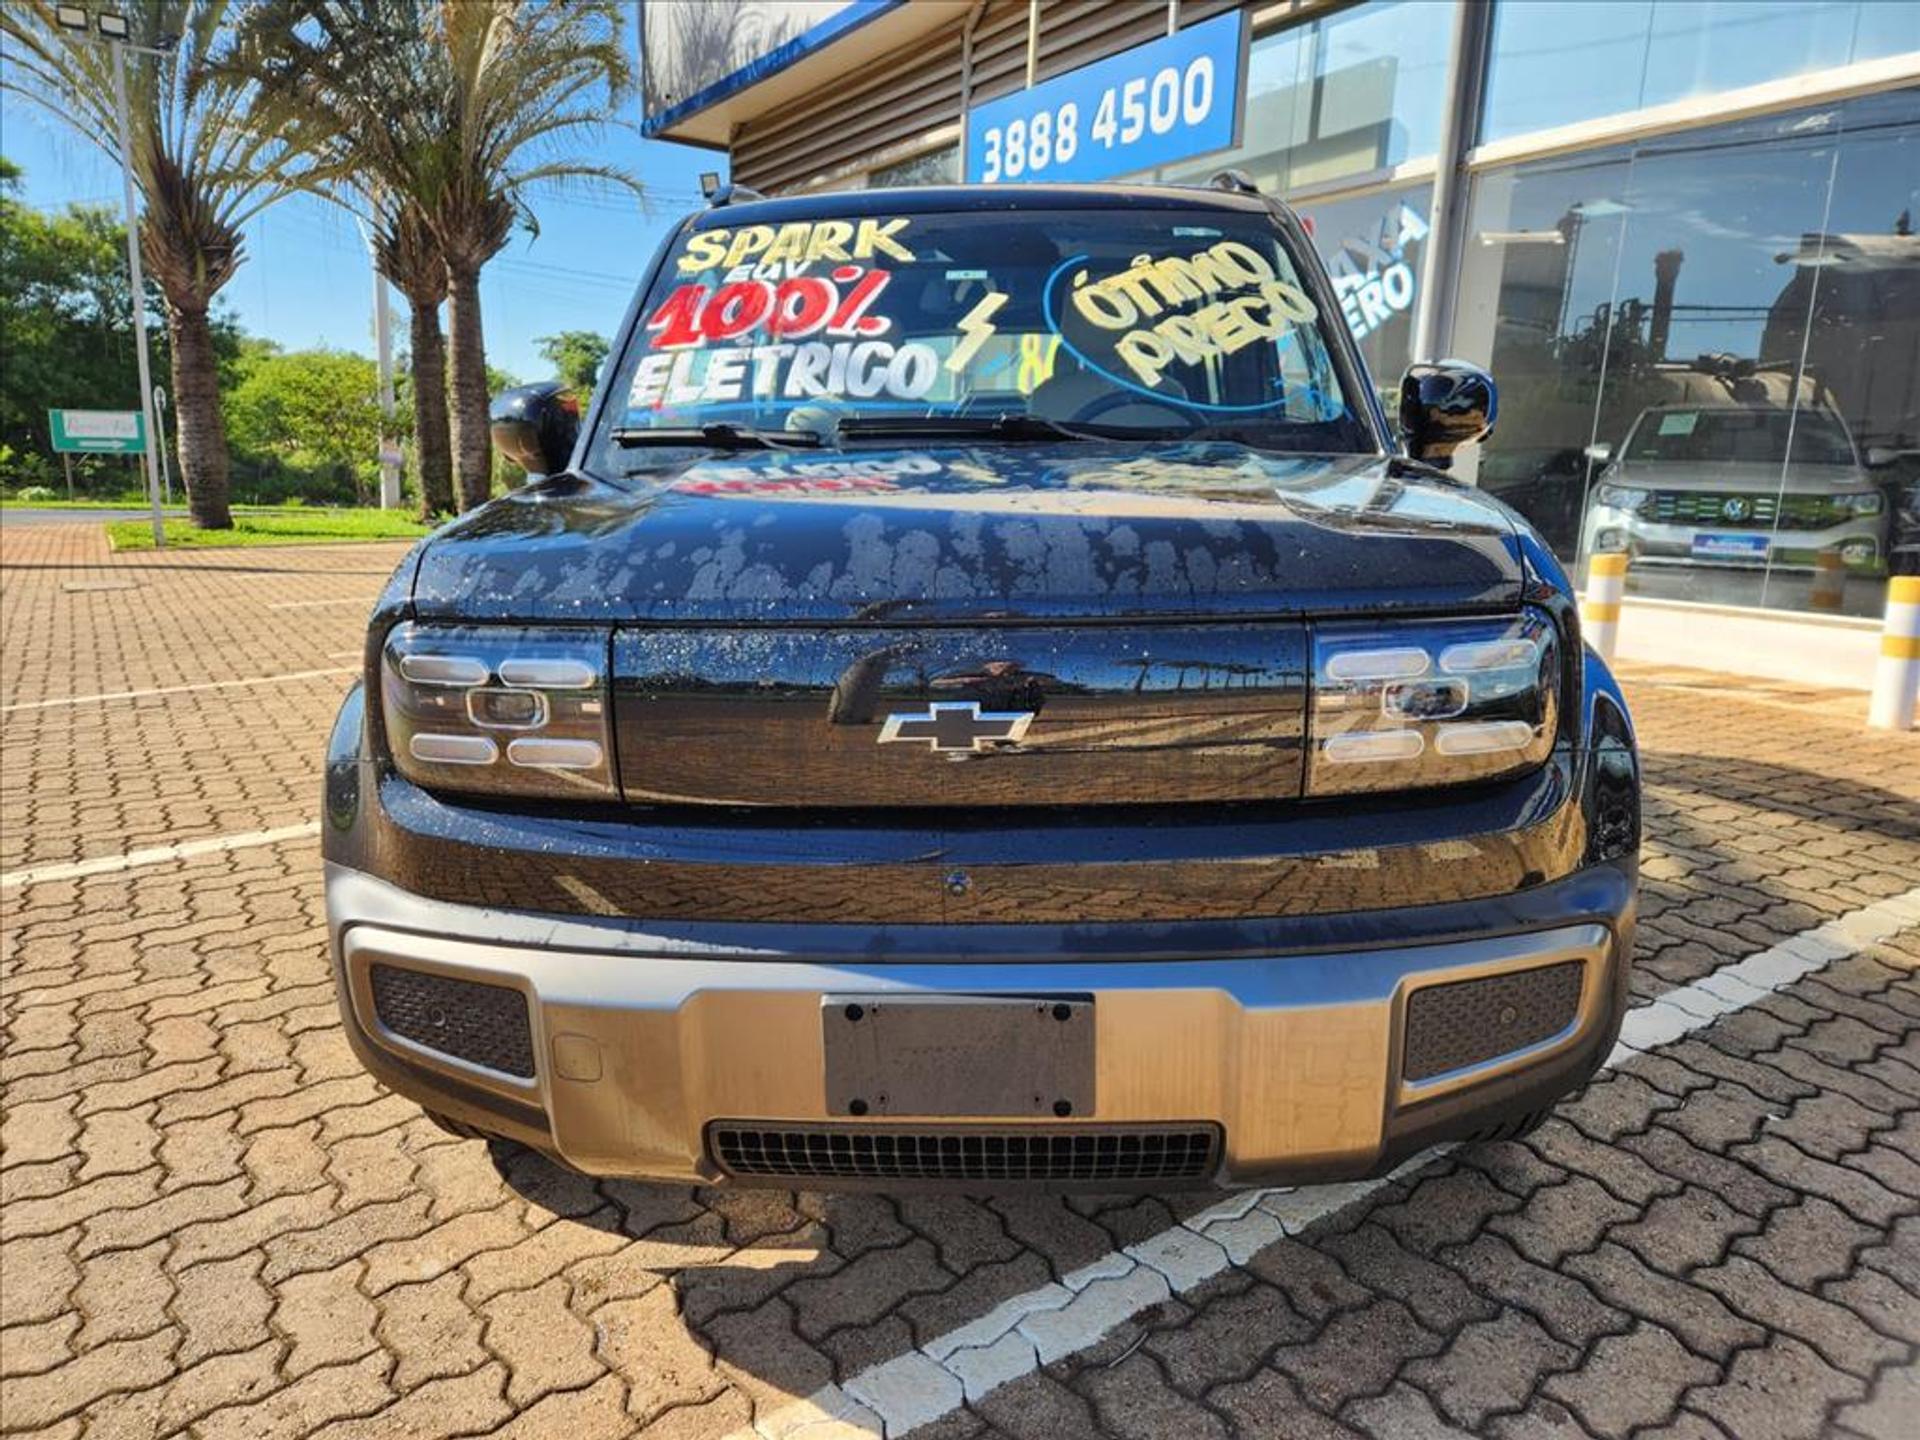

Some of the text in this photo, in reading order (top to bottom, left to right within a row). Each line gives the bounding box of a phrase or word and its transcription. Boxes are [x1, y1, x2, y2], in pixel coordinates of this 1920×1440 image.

[983, 56, 1214, 184] 3888 4500
[677, 218, 916, 272] SPARK
[1328, 203, 1429, 298] AXA
[648, 265, 892, 350] 100%
[1342, 262, 1415, 341] ERO
